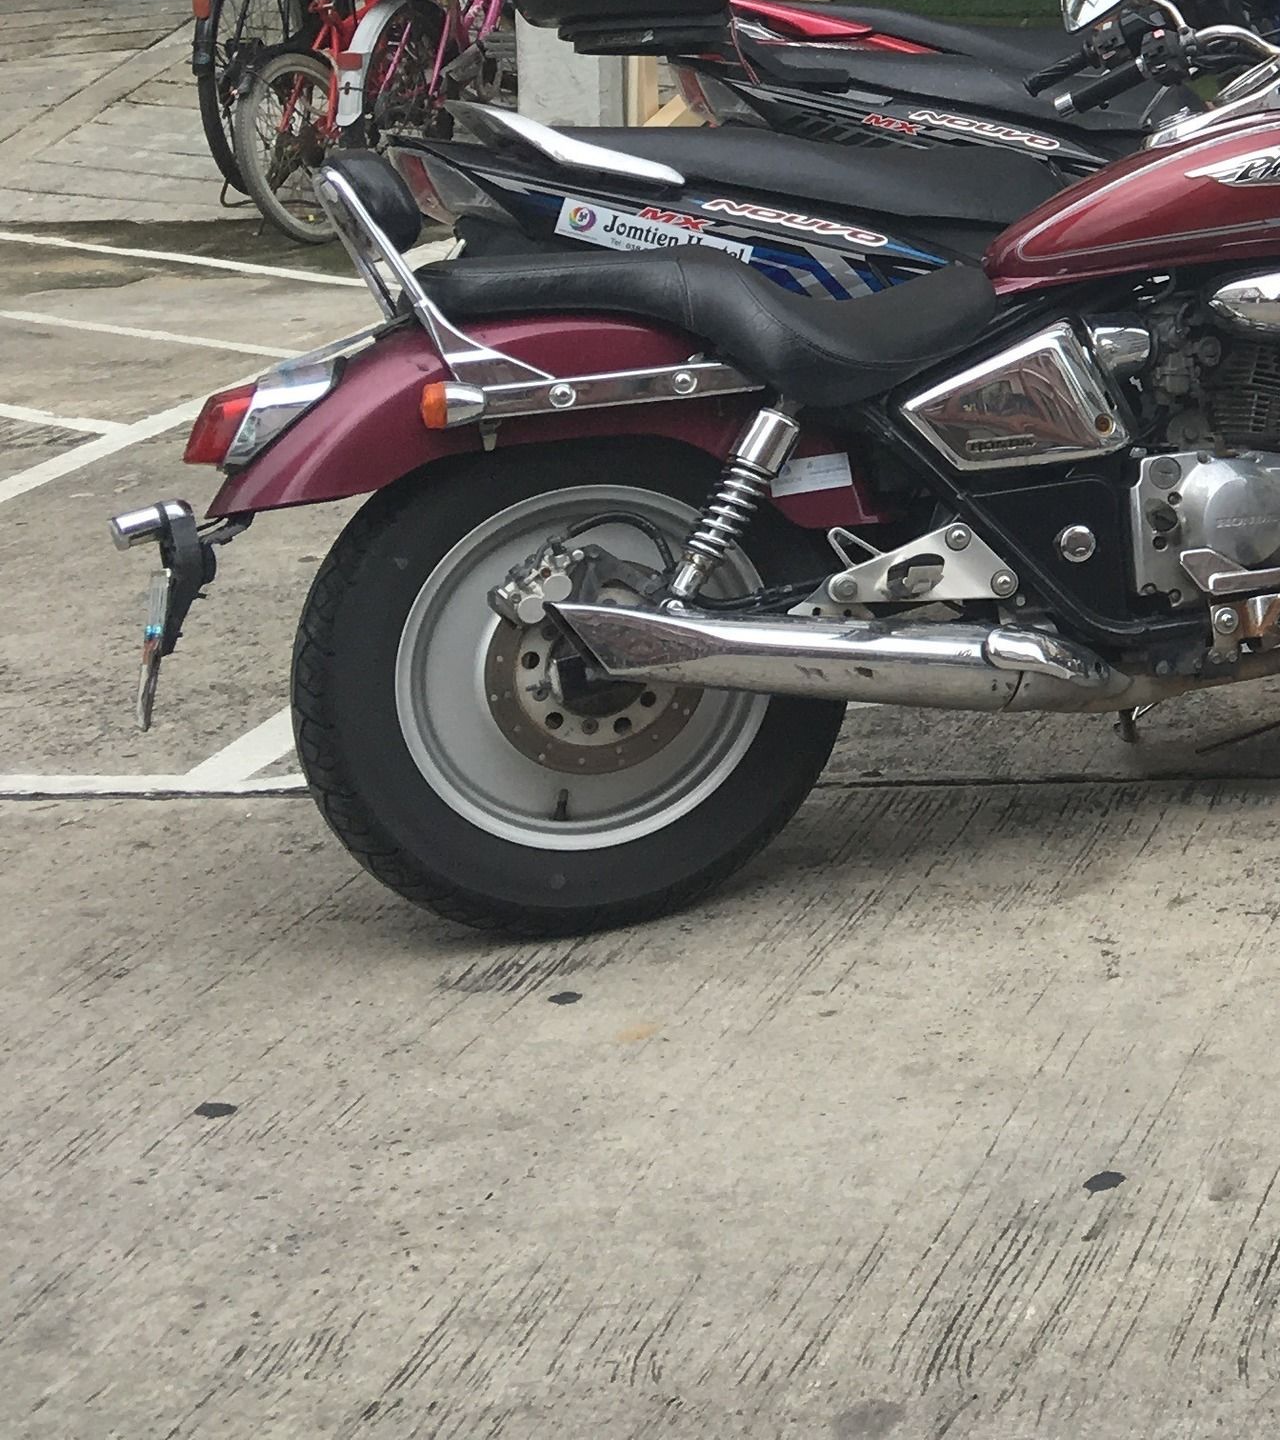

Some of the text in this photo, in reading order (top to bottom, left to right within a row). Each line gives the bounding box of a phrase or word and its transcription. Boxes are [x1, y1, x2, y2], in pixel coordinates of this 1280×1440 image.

[861, 113, 924, 135] MX
[908, 111, 1060, 149] NOUVO
[603, 215, 679, 247] Jomtien
[638, 207, 712, 233] MX
[702, 199, 888, 246] NOUVO
